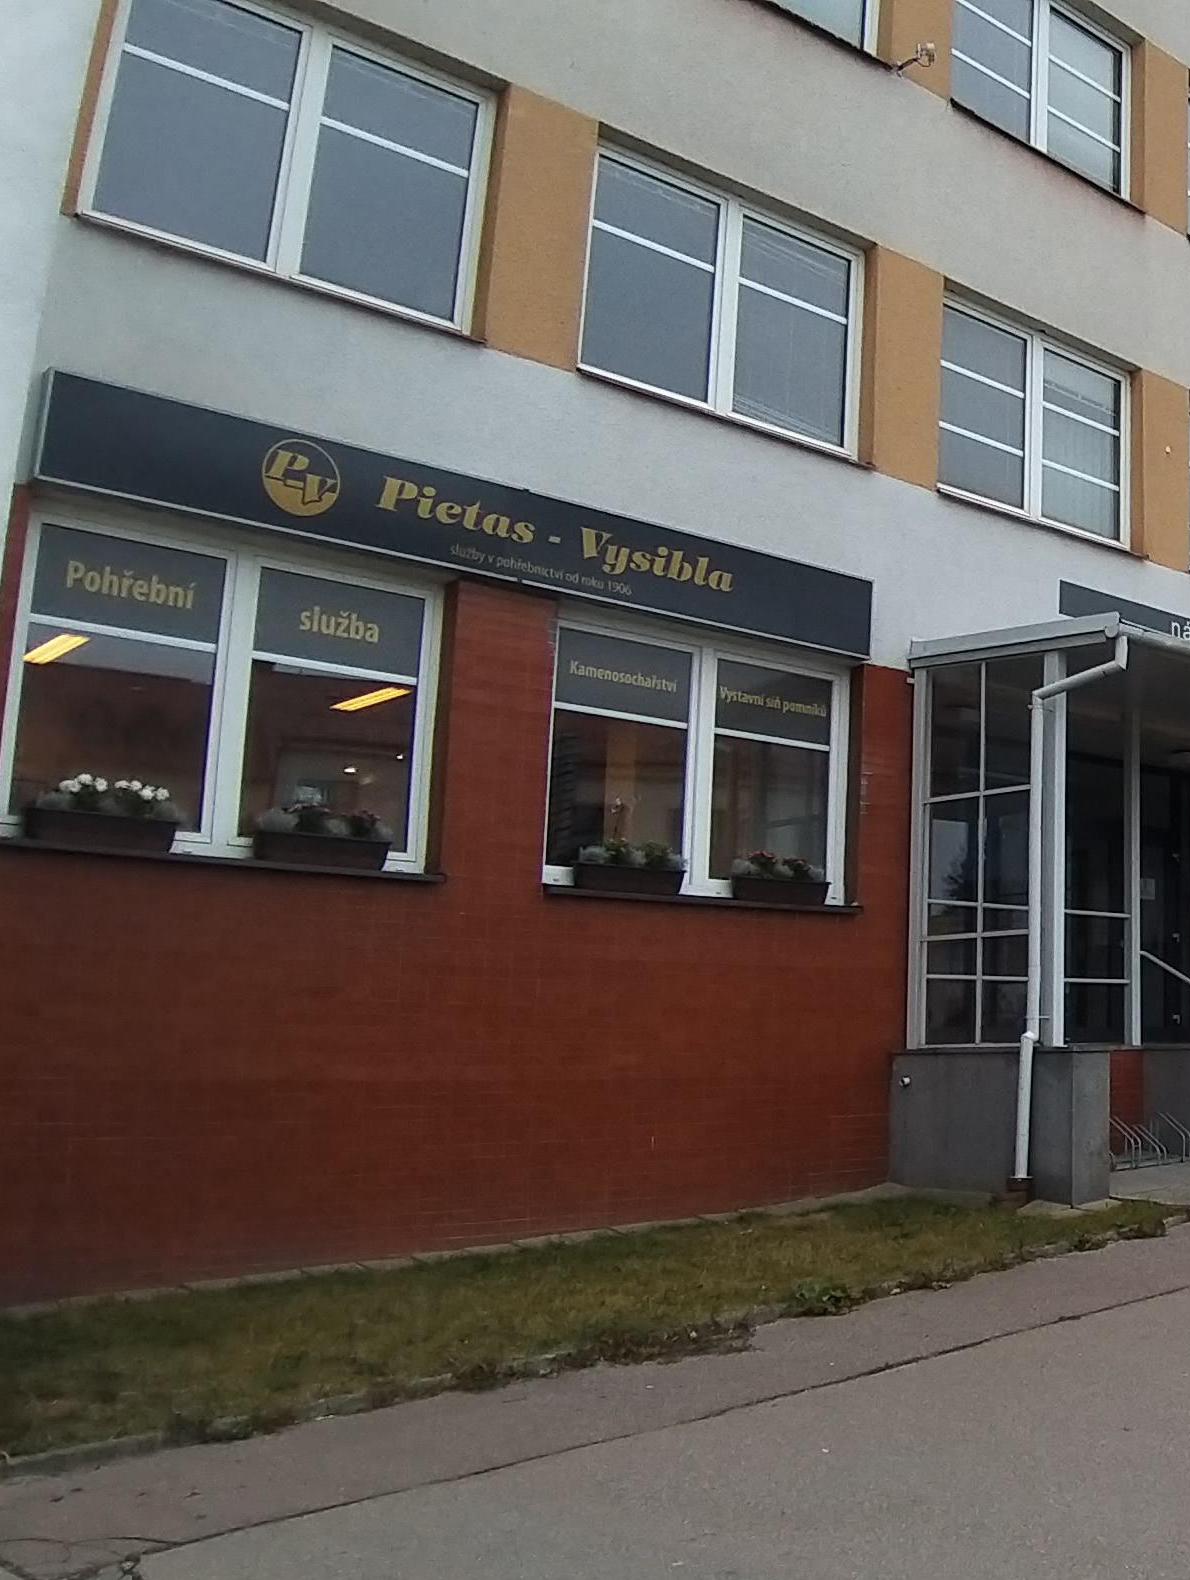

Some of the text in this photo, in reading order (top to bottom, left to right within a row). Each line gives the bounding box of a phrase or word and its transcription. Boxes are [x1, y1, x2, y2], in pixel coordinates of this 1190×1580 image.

[375, 475, 536, 544] Pietas
[579, 526, 735, 593] Vysibla
[65, 559, 197, 610] Pohřební
[450, 543, 486, 564] služby
[565, 570, 579, 584] od
[581, 575, 605, 590] roku
[606, 579, 633, 597] 1906
[299, 605, 381, 644] služba
